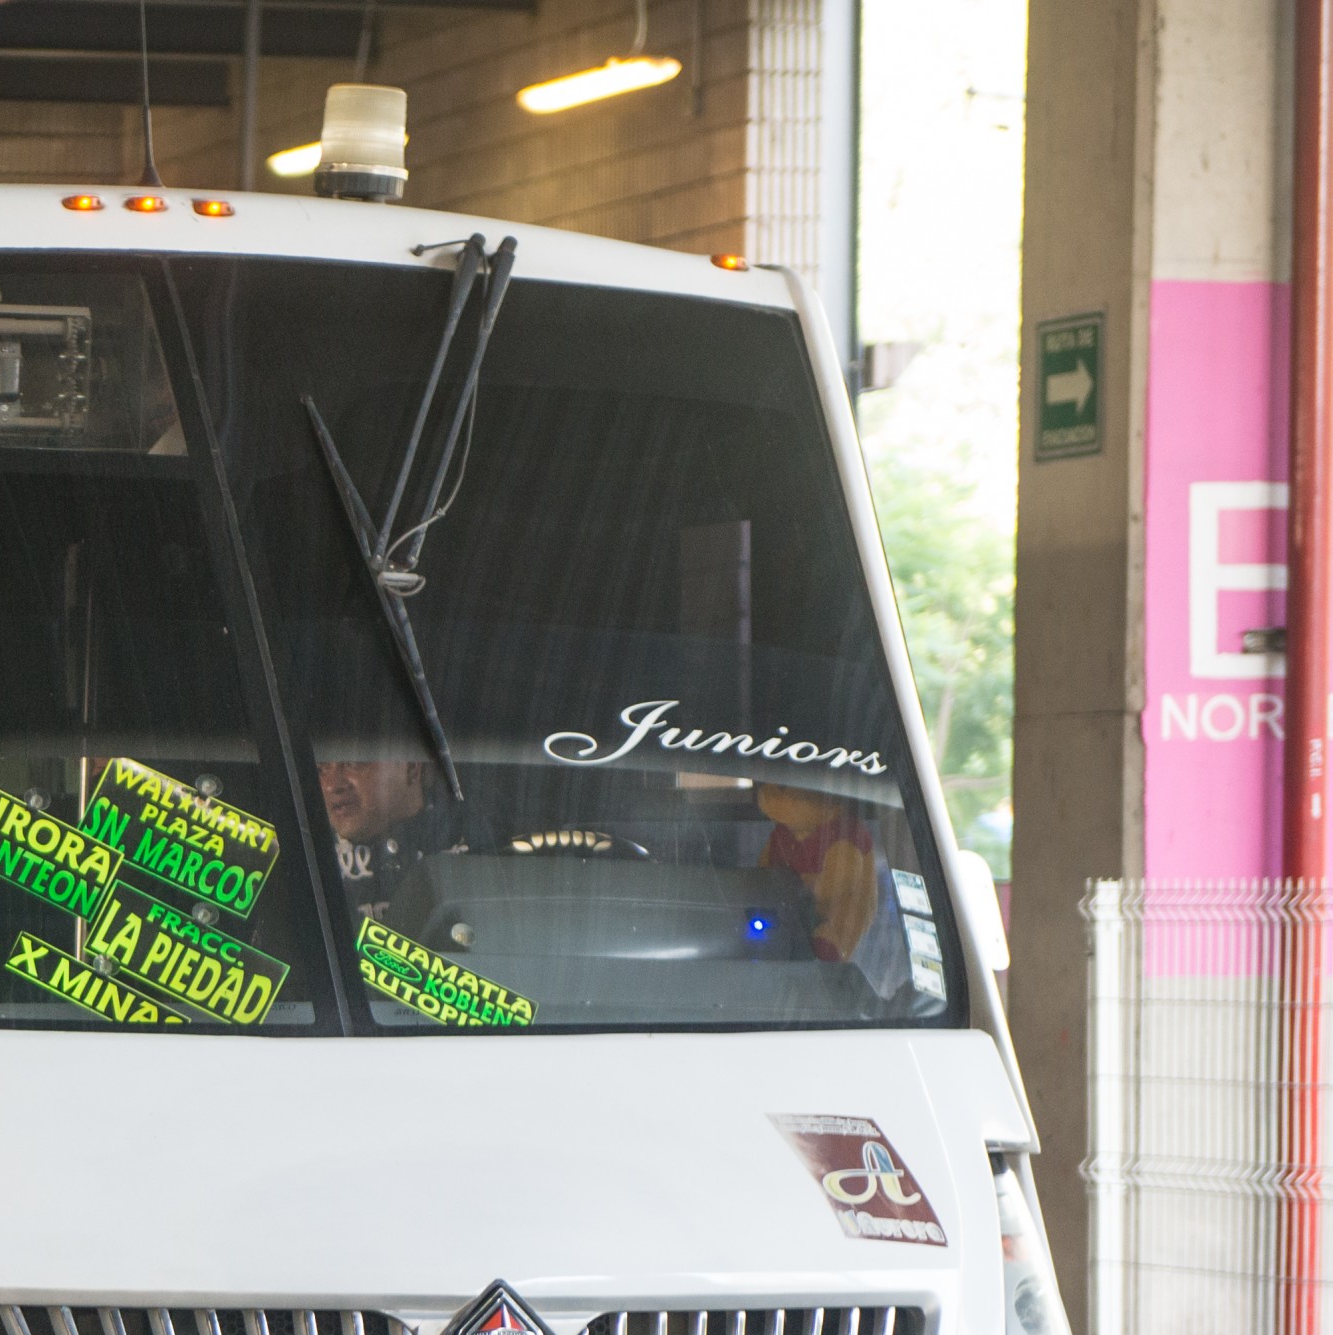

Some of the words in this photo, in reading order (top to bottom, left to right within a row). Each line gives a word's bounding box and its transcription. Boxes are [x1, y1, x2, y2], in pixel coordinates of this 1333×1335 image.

[1190, 482, 1289, 679] E
[544, 700, 887, 775] Juniors
[84, 796, 131, 853] SN.
[133, 828, 264, 911] MARCOS
[139, 803, 225, 858] PLAZA
[9, 935, 49, 978] X
[90, 898, 143, 966] LA
[139, 931, 273, 1025] PIEDAD
[367, 924, 533, 1020] CUAMATLA
[424, 973, 529, 1027] KOBLEN
